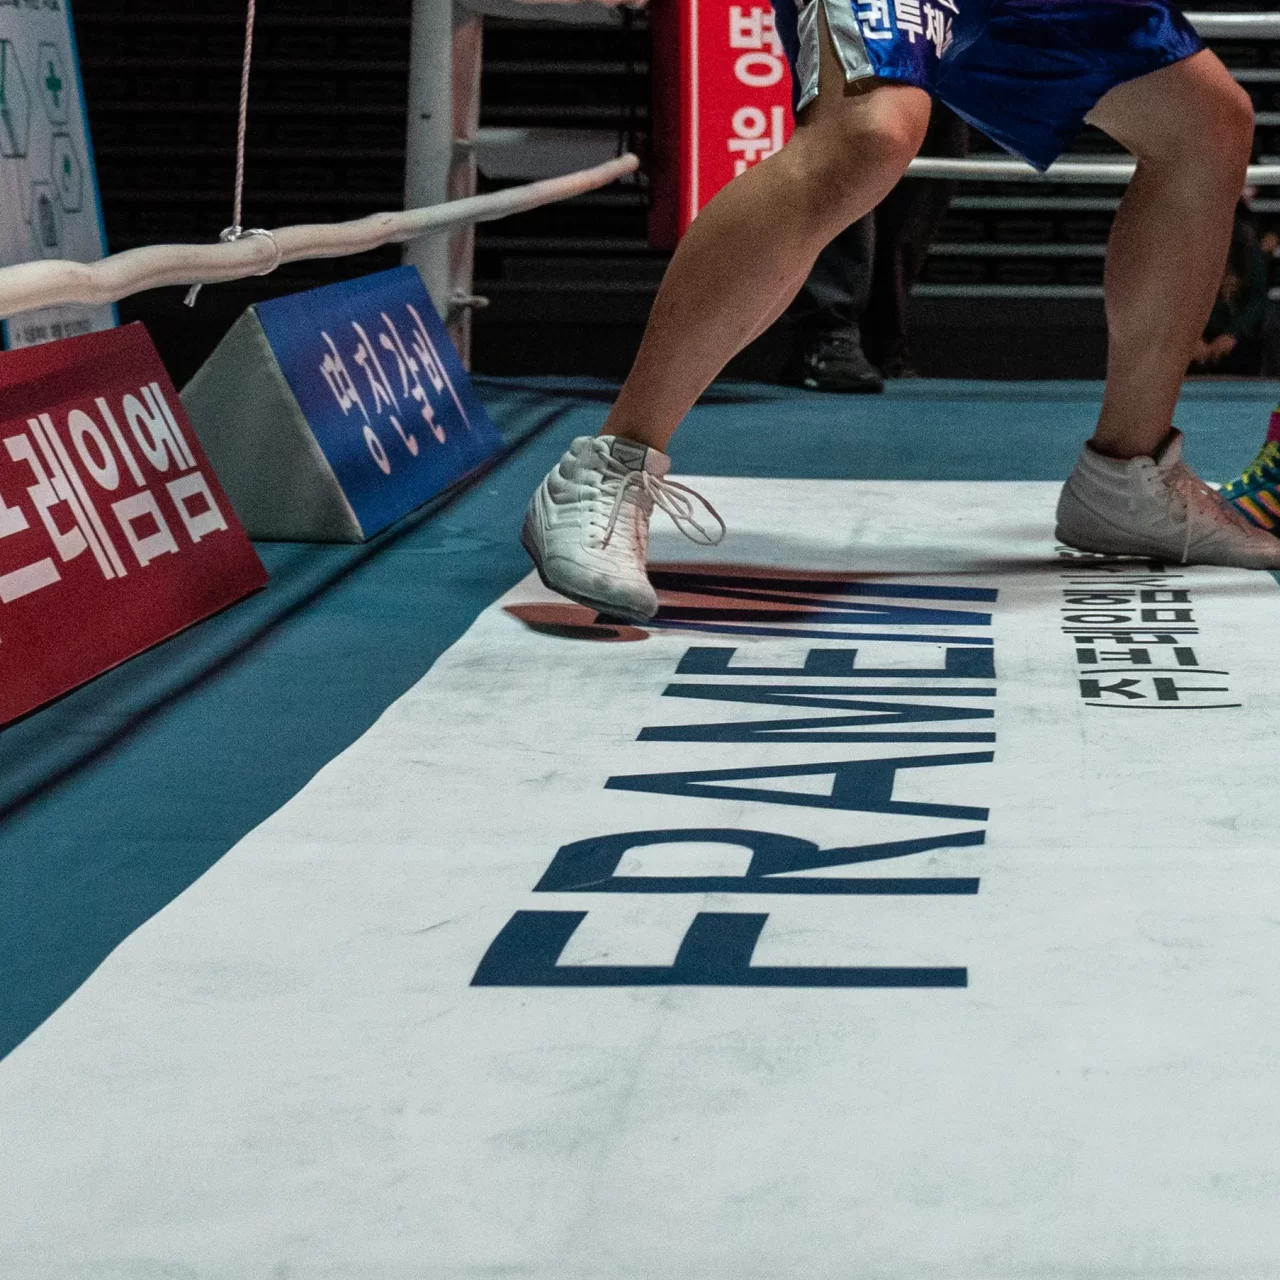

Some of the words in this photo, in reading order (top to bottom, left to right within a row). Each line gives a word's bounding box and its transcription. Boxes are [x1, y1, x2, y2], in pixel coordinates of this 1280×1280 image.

[319, 303, 472, 477] 명진갈비
[1054, 545, 1243, 710] (주)프레임엠시
[468, 572, 999, 988] FRAMEM
